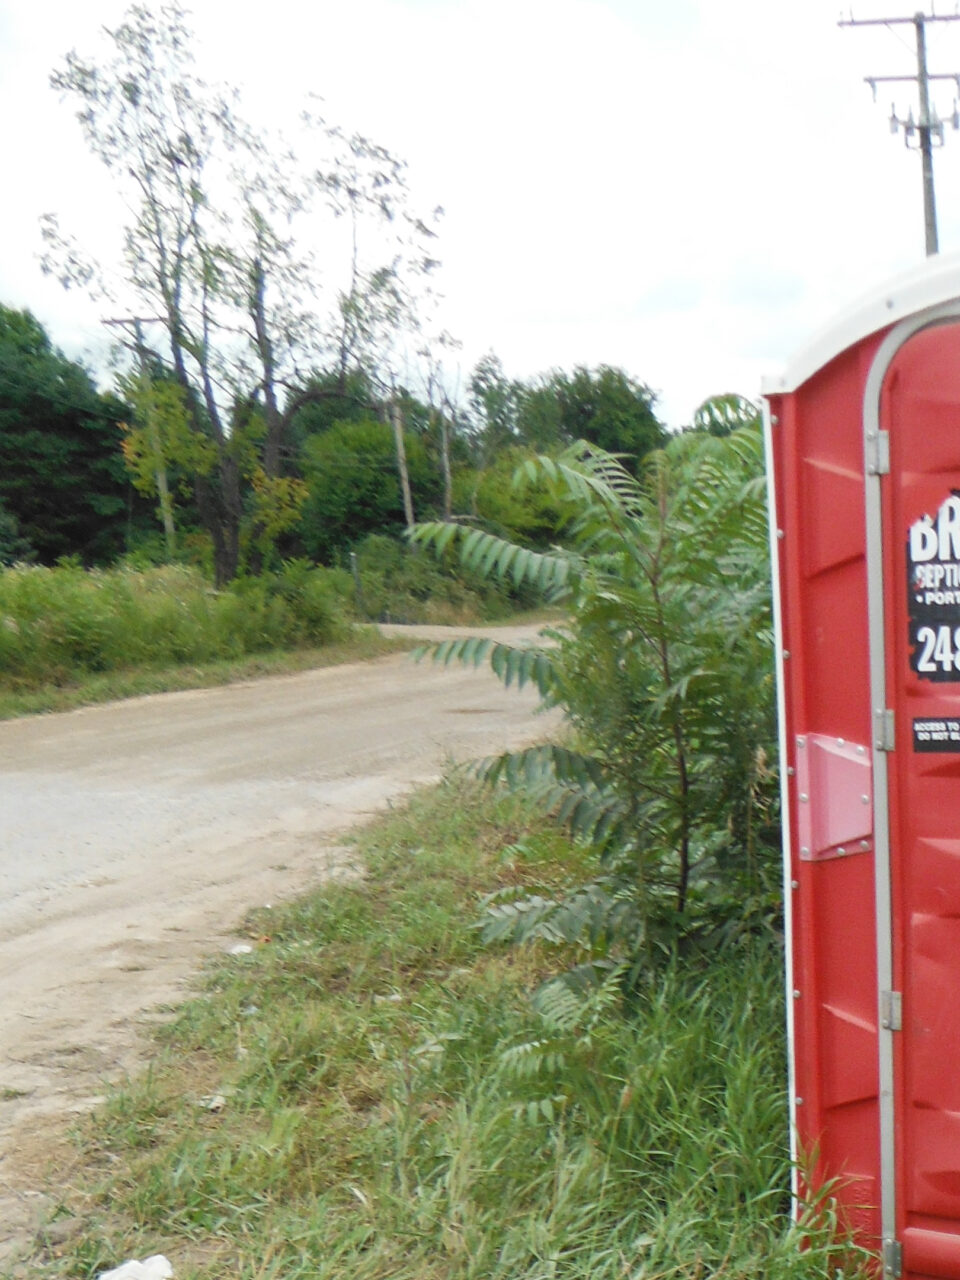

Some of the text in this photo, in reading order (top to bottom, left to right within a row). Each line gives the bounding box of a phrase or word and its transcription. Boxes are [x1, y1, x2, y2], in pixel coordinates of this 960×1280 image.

[913, 722, 946, 732] ACCESS
[947, 722, 960, 731] TO
[917, 731, 931, 740] DO
[931, 731, 949, 740] NOT
